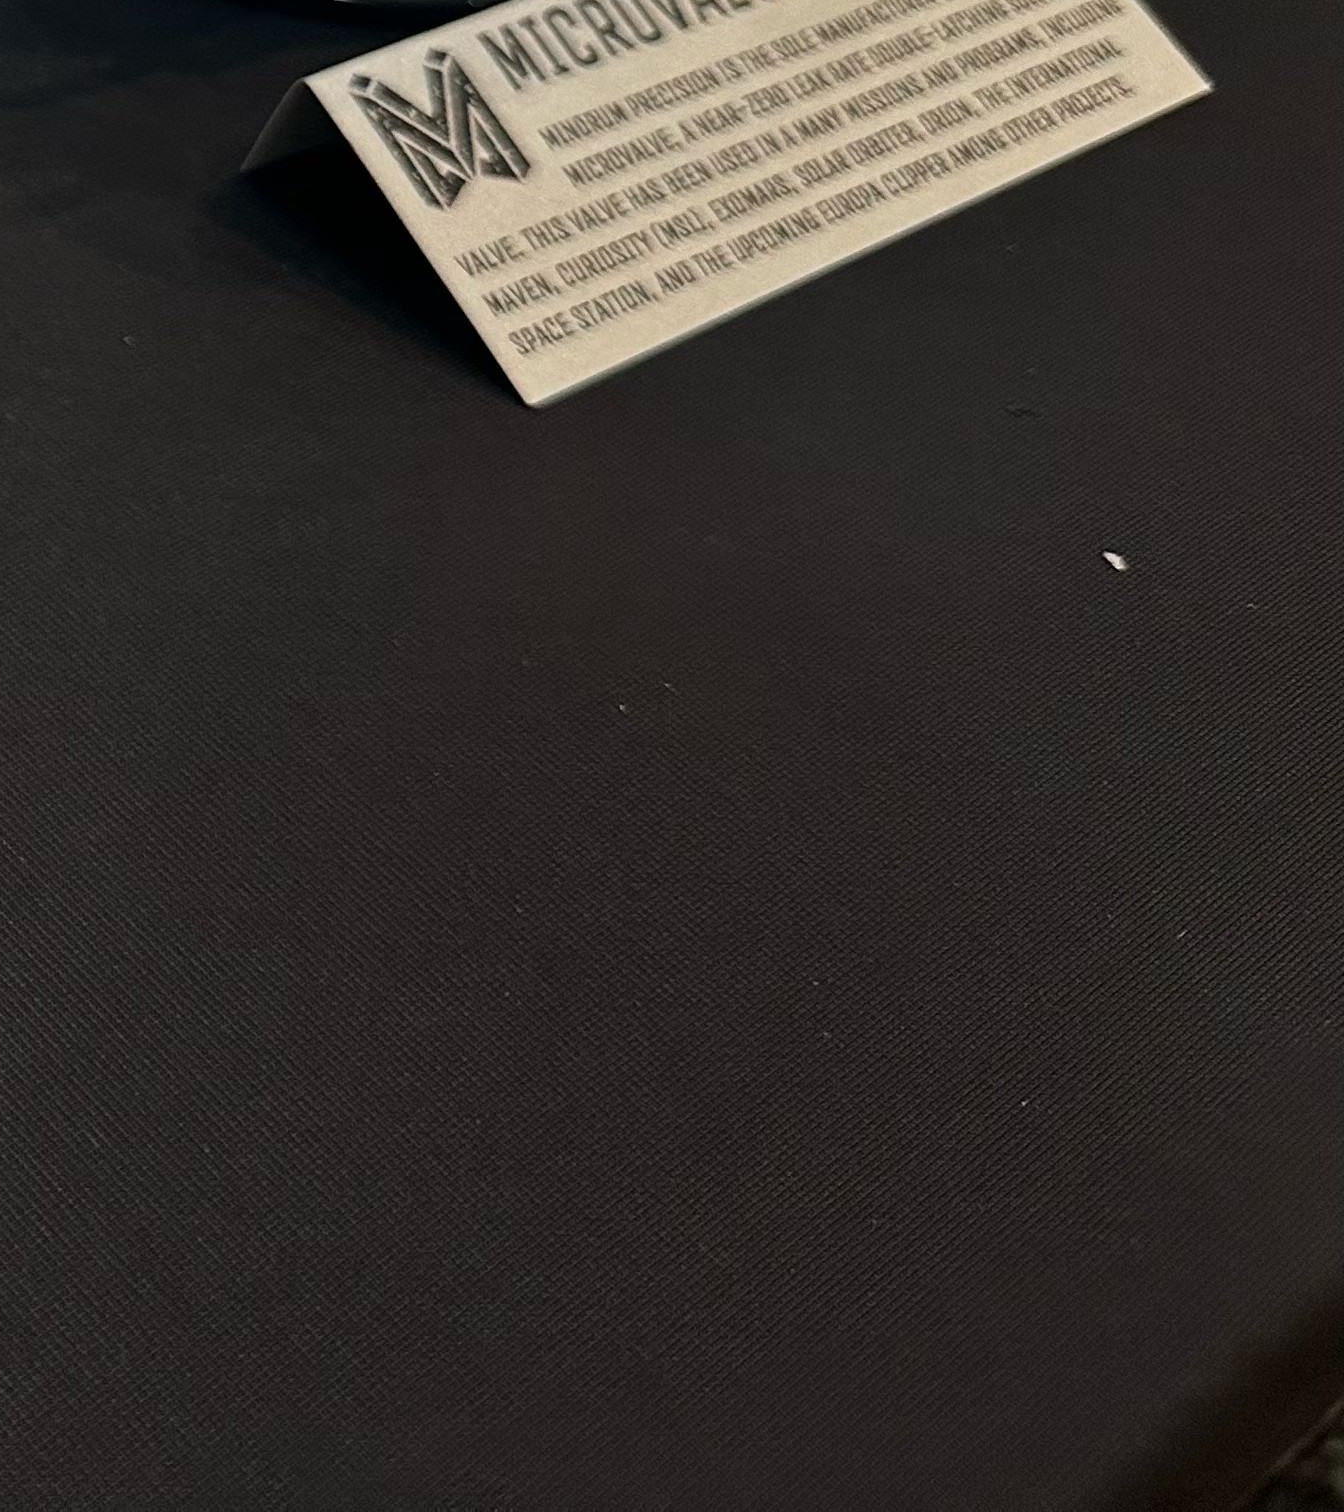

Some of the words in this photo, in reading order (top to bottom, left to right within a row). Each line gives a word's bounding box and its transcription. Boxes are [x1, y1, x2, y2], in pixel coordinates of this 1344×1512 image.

[481, 269, 560, 318] MAVEN,
[553, 228, 658, 287] CURIOSITY
[708, 170, 798, 222] EXOMARS,
[789, 148, 851, 188] SOLAR
[842, 118, 924, 165] ORBITER,
[914, 95, 980, 135] ORION,
[970, 80, 1015, 112] THE
[1008, 35, 1124, 95] INTERNATIONAL
[520, 216, 572, 251] THIS
[563, 191, 634, 234] VALVE
[622, 177, 667, 209] HAS
[659, 158, 714, 194] BEEN
[705, 139, 760, 175] USED
[751, 130, 783, 156] IN
[773, 123, 799, 148] A
[789, 104, 848, 141] MANY
[838, 72, 926, 121] MISSIONS
[915, 58, 960, 89] AND
[950, 24, 1045, 75] PROGRAMS,
[536, 100, 631, 152] MINDRUM
[622, 65, 722, 118] PRECISION
[713, 56, 745, 83] IS
[734, 43, 778, 75] THE
[768, 27, 820, 61] SOLE
[672, 119, 698, 144] A
[689, 82, 792, 138] NEAR-ZERO
[783, 66, 832, 100] LEAK
[823, 50, 873, 83] RATE
[505, 310, 578, 357] SPACE
[566, 276, 658, 331] STATION,
[648, 258, 700, 295] AND
[689, 242, 737, 277] THE
[724, 205, 824, 262] UPCOMING
[813, 177, 889, 224] EUROPA
[876, 150, 953, 196] CLIPPER
[940, 125, 1011, 169] AMONG
[998, 104, 1059, 144] OTHER
